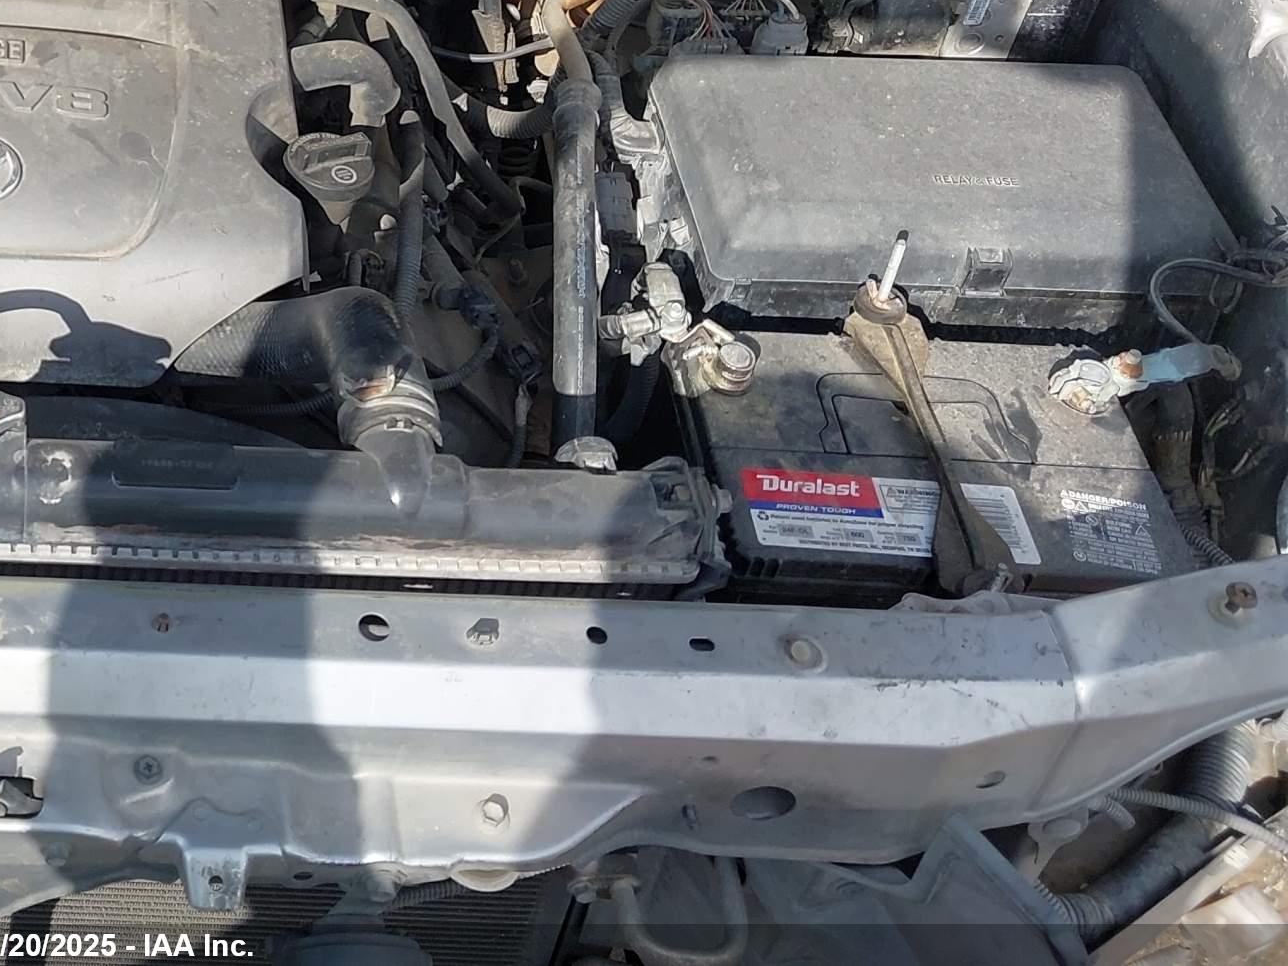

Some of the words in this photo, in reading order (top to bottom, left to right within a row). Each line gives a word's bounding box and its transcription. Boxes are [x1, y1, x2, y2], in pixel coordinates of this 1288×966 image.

[932, 175, 973, 186] RELAY
[985, 176, 1021, 188] FUSE
[756, 474, 860, 497] Duralast
[775, 503, 819, 513] PROVEN
[821, 505, 856, 515] TOUGH
